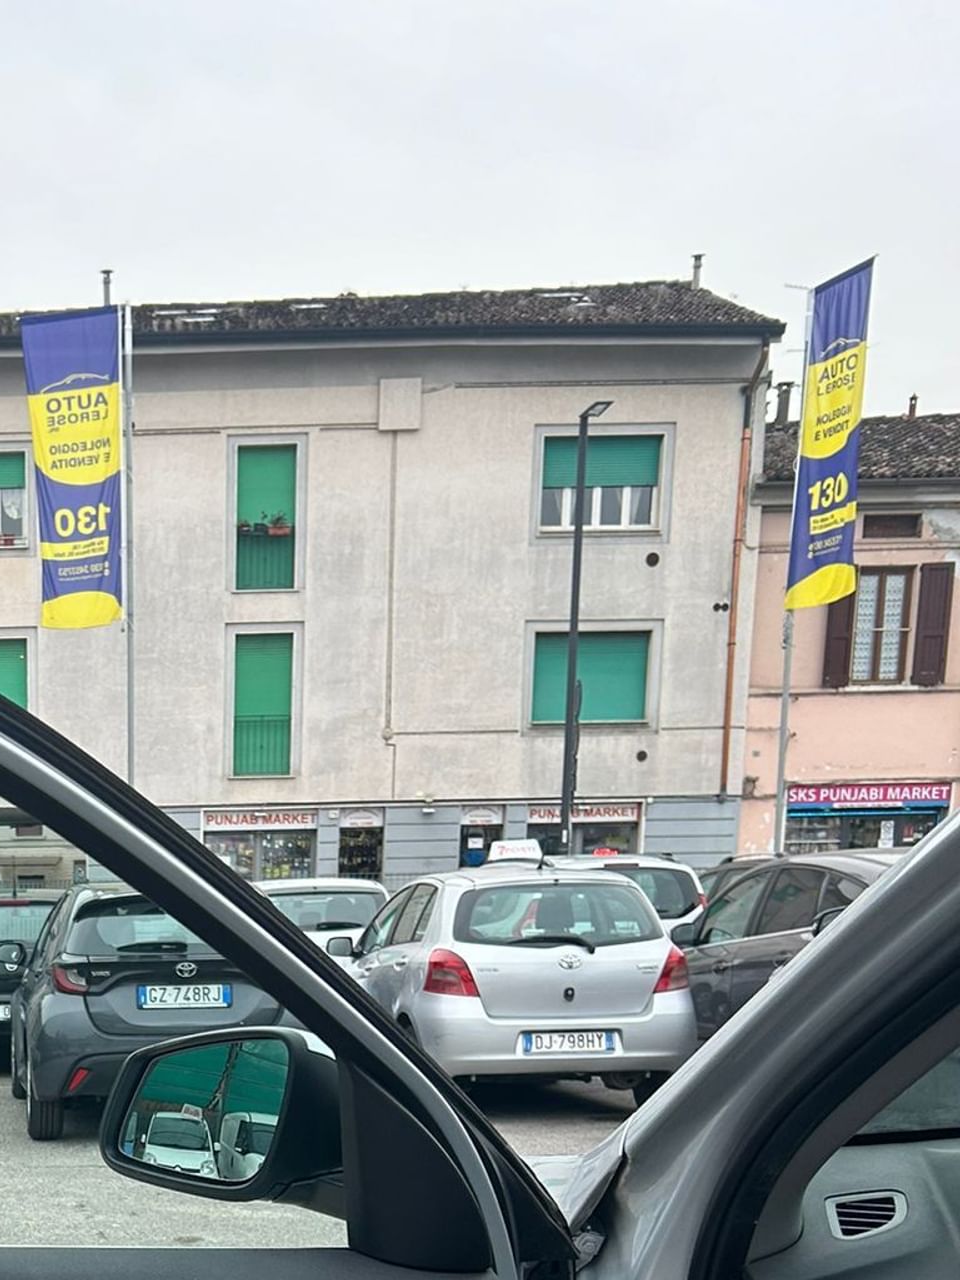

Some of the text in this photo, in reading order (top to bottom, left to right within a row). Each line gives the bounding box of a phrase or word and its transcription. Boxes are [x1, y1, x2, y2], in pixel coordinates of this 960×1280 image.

[818, 354, 859, 383] AUTO
[808, 472, 848, 510] 130
[789, 786, 950, 802] SKS PUNJABI MARKET
[206, 814, 258, 825] PUNJAB
[262, 812, 317, 824] MARKET
[583, 806, 637, 818] MARKET
[148, 986, 221, 1003] GZ 748RJ
[534, 1033, 604, 1050] DJ 798HY
